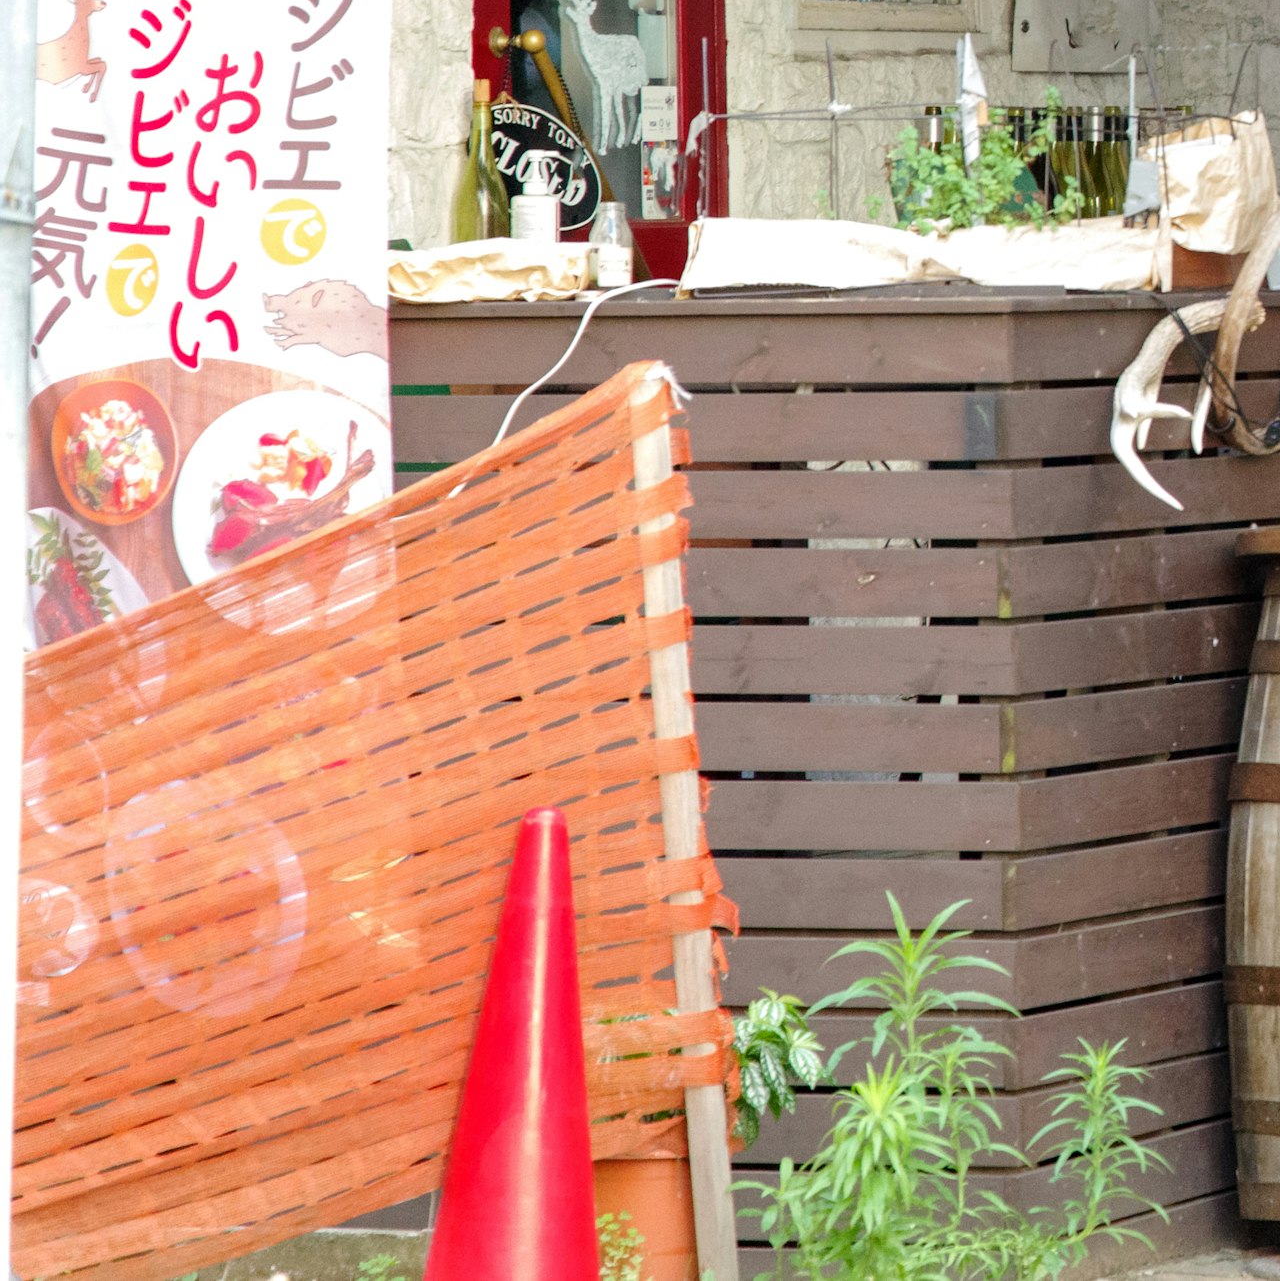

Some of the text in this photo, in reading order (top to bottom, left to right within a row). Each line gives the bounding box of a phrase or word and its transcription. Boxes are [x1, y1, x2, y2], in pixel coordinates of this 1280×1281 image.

[493, 108, 540, 130] SORRY
[168, 51, 264, 369] おいしい
